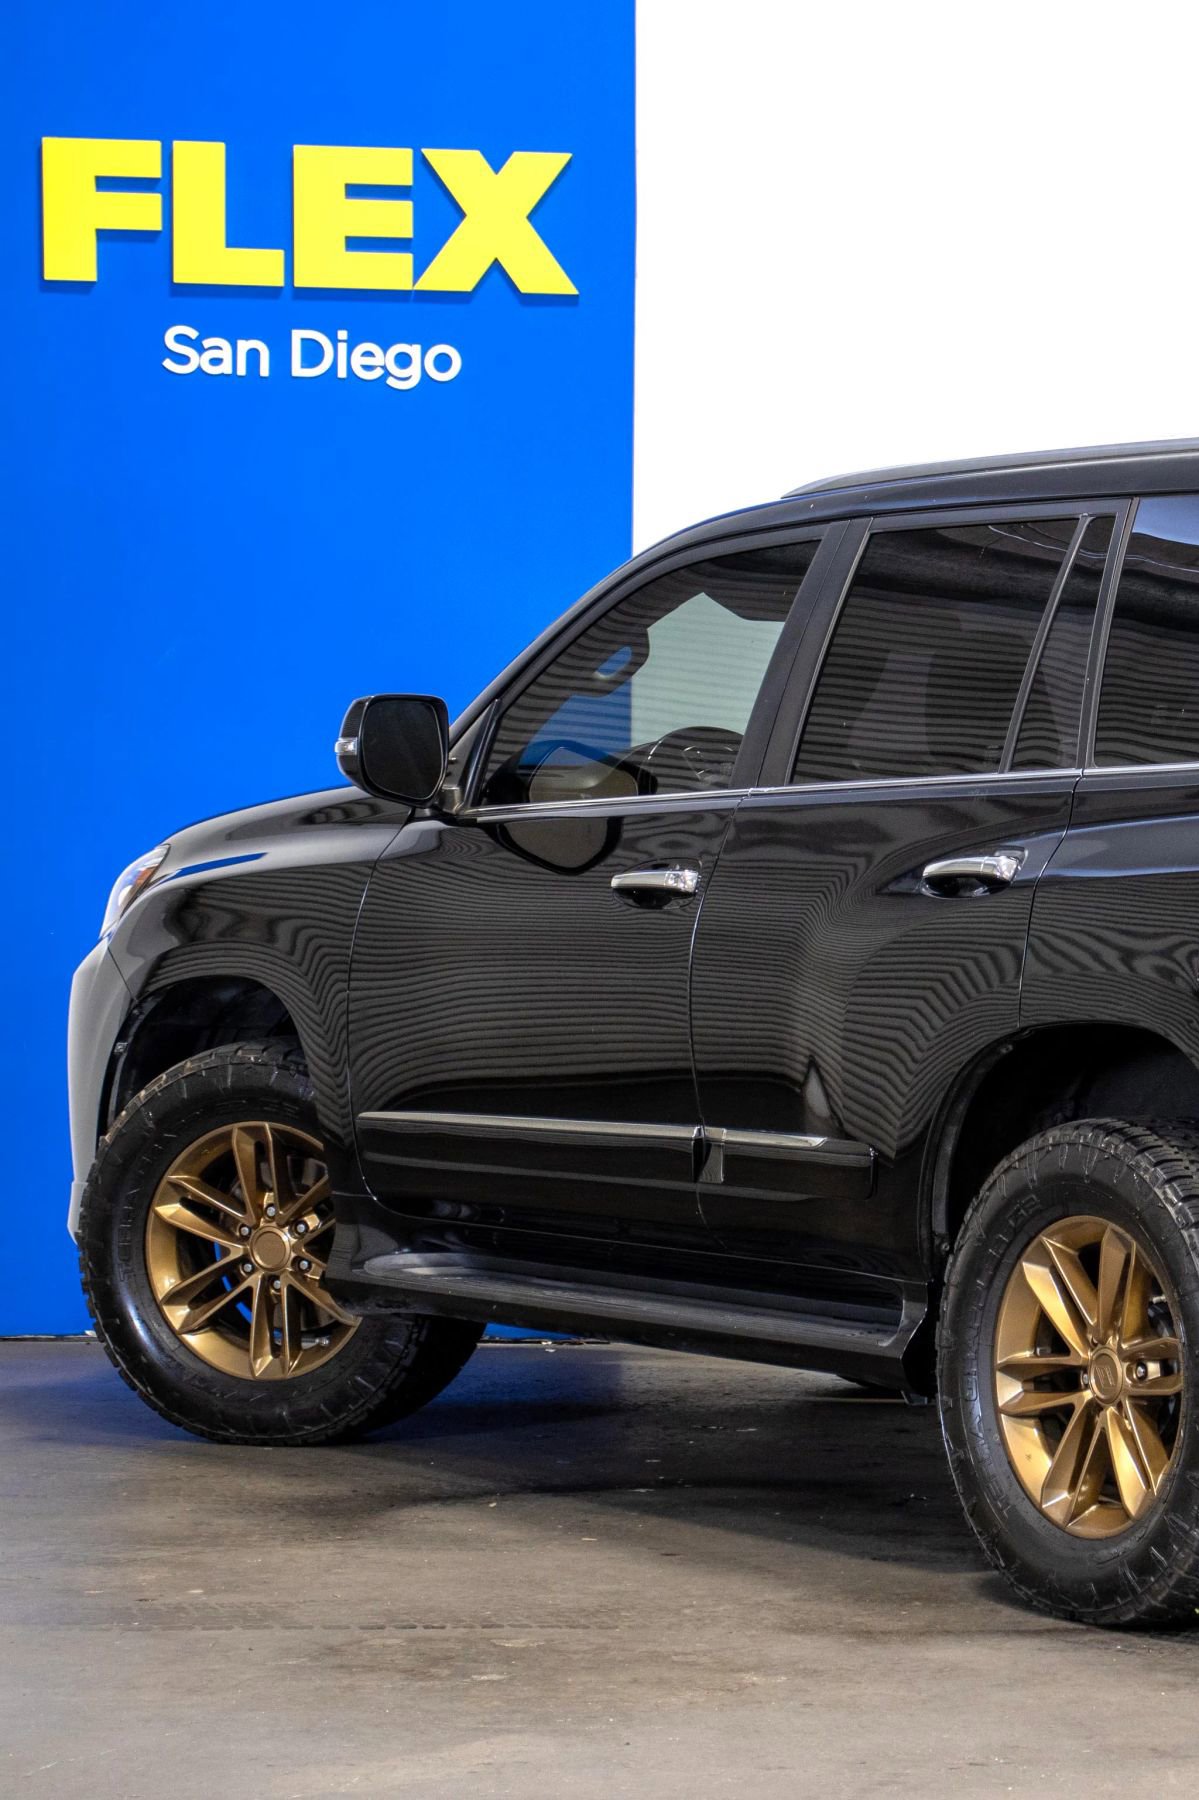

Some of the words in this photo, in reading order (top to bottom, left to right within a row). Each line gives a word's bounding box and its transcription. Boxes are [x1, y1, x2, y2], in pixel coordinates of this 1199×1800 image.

[42, 137, 579, 295] FLEX
[162, 325, 270, 377] San
[291, 329, 462, 390] Diego
